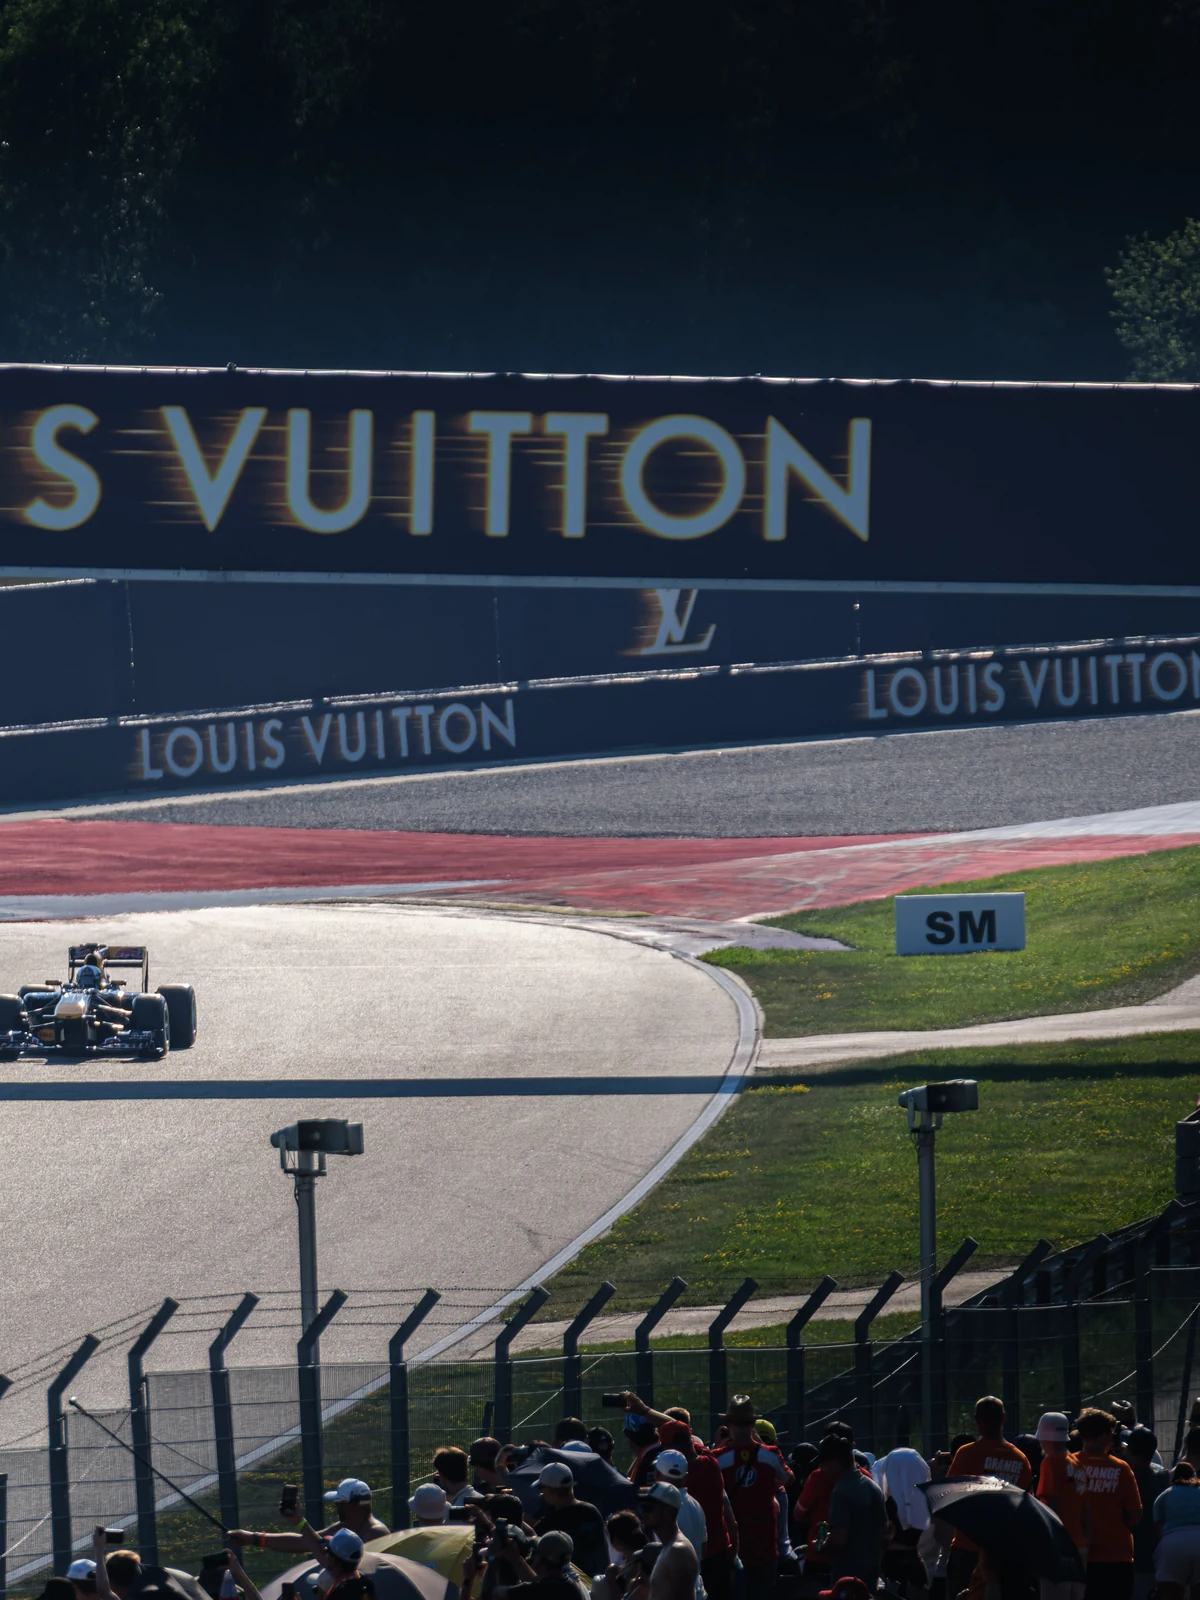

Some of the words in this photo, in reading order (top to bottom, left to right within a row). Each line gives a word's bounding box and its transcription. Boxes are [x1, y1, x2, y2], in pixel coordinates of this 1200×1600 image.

[161, 405, 872, 541] VUITTON
[867, 662, 1005, 719] LOUIS
[1020, 649, 1200, 709] VUITTO
[141, 718, 286, 779] LOUIS
[301, 699, 517, 765] VUITTON
[925, 909, 997, 945] SM
[1082, 1465, 1121, 1480] RANGE
